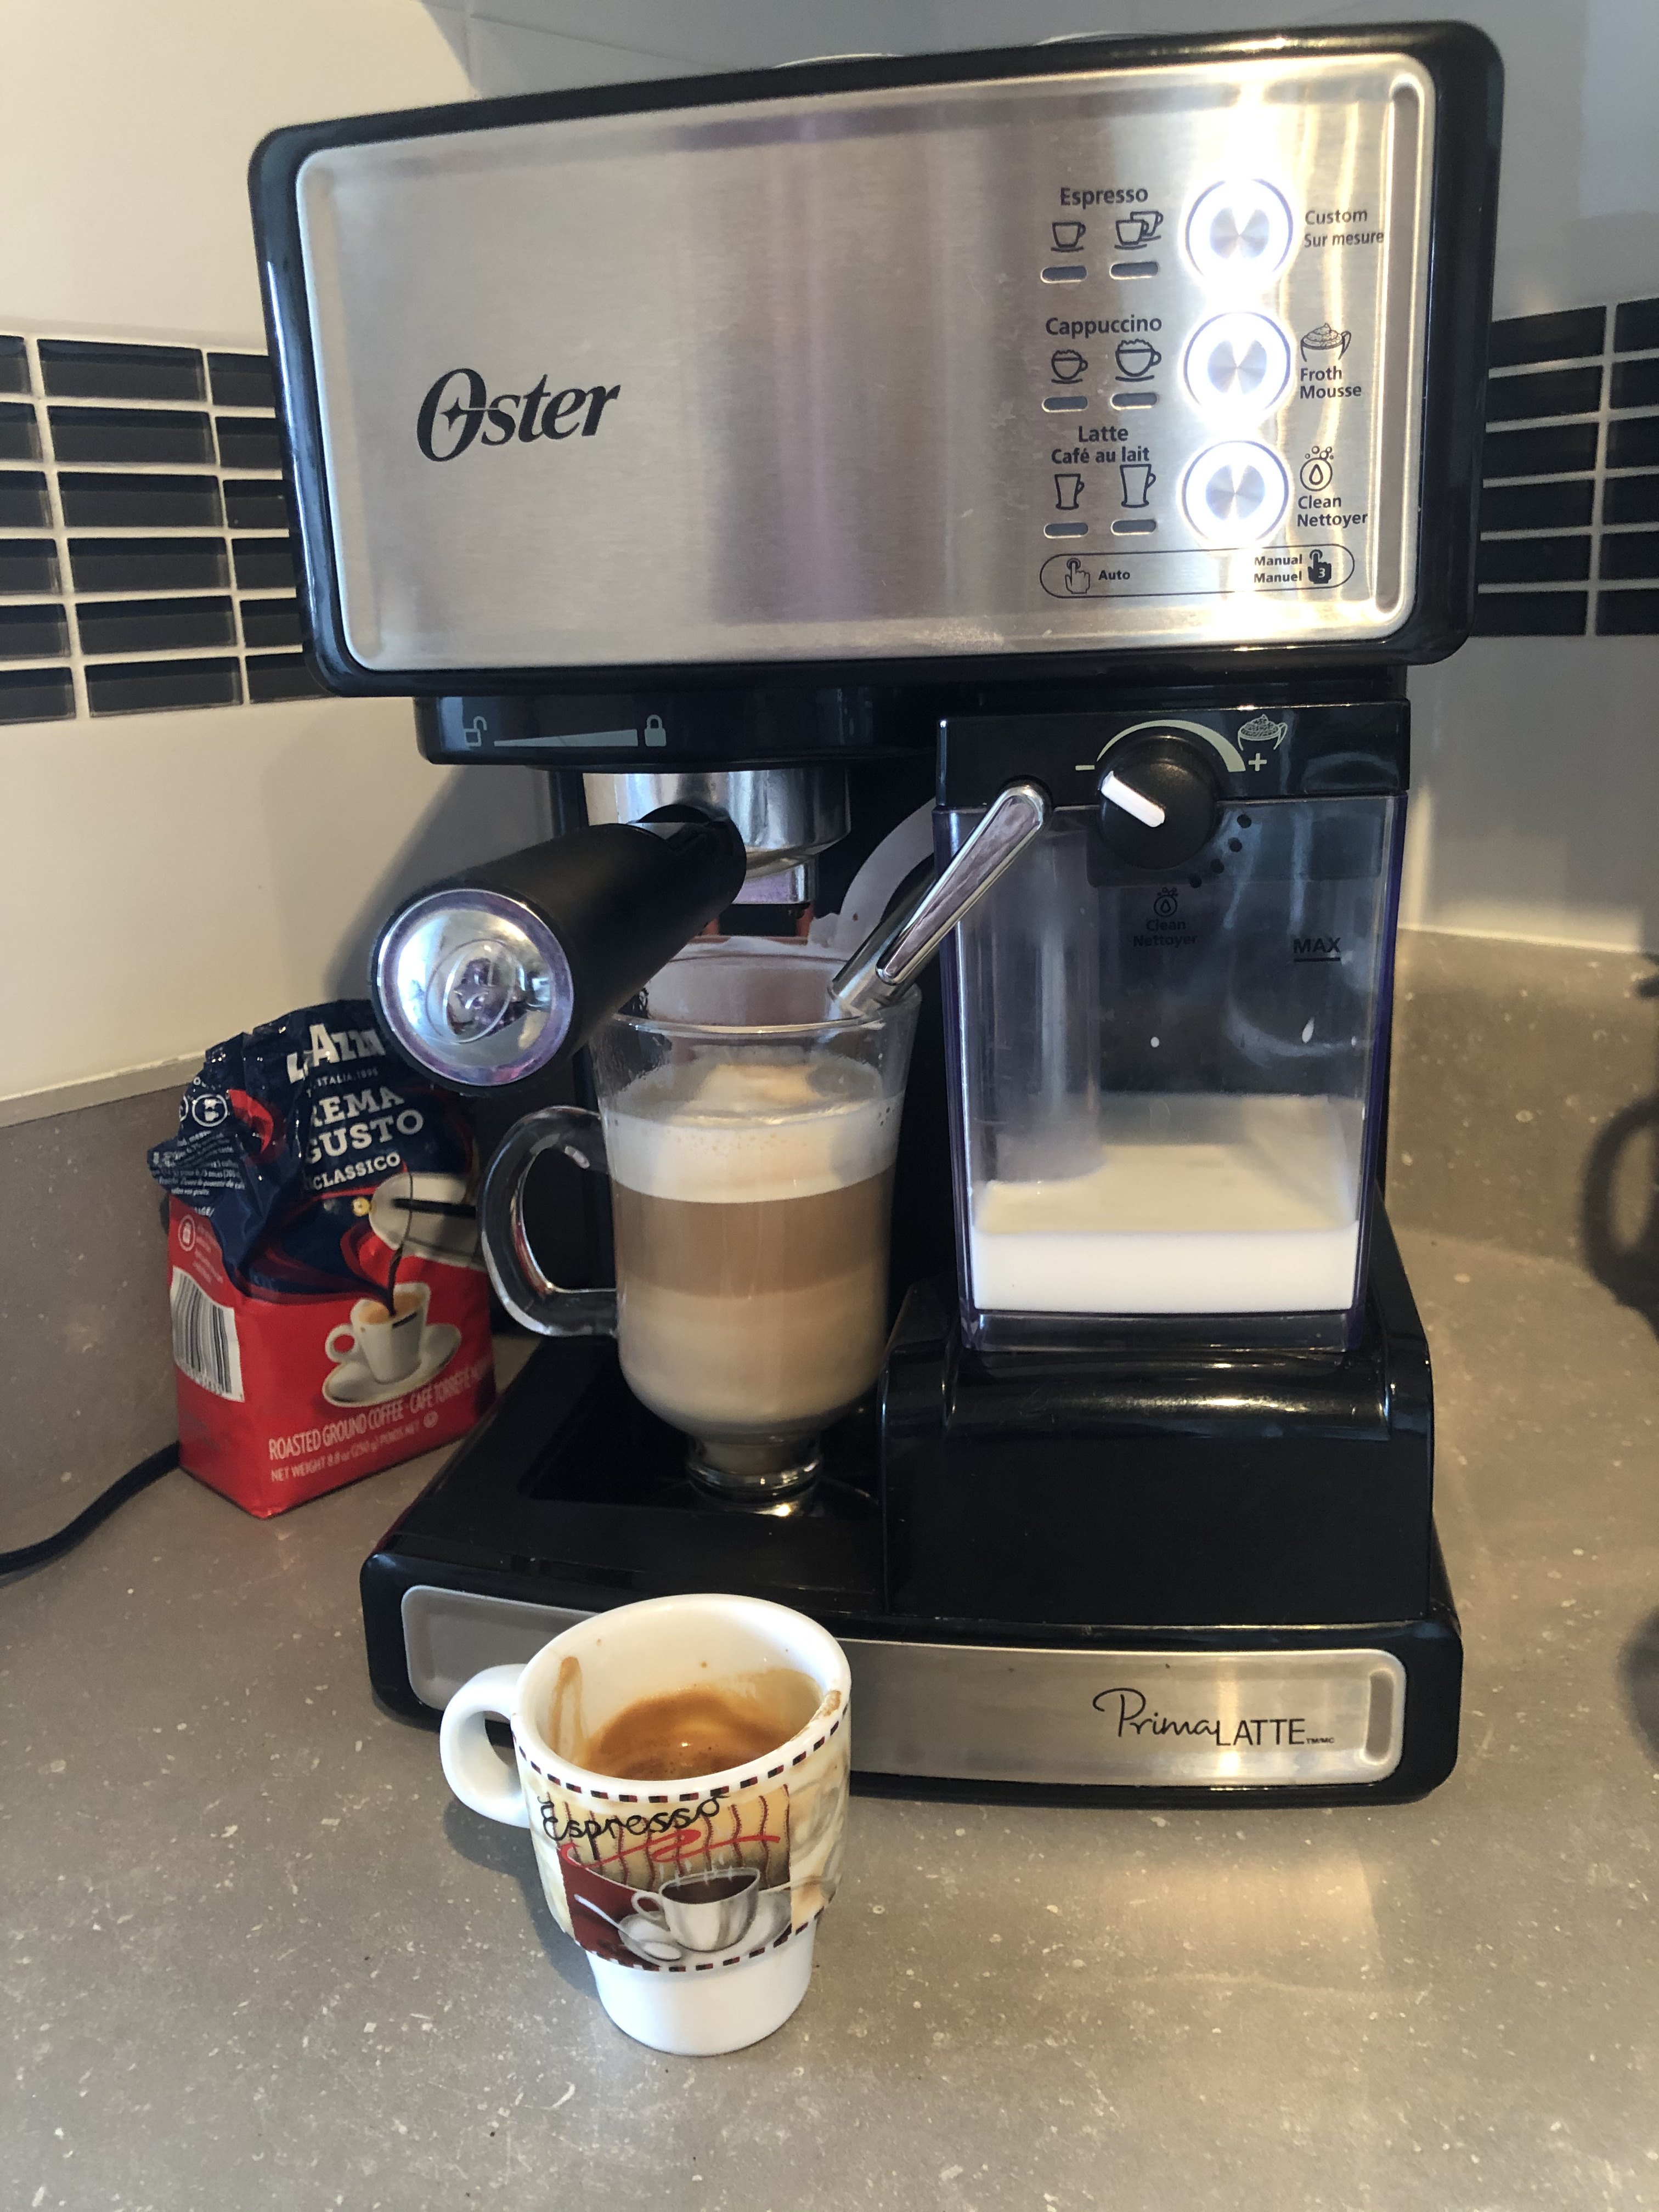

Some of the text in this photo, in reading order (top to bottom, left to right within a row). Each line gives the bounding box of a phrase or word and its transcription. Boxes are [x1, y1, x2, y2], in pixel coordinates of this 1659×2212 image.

[1060, 187, 1148, 207] Espresso
[1305, 209, 1368, 225] Custom
[1304, 229, 1384, 248] Sur mesure
[1046, 314, 1163, 339] Cappuccino
[1300, 365, 1342, 382] Froth
[1300, 383, 1362, 399] Mousse
[417, 368, 621, 462] Oster
[1078, 425, 1128, 443] Latte
[1052, 447, 1149, 465] Café au lait
[1297, 495, 1342, 509] Clean
[1297, 511, 1368, 528] Nettoyer
[1254, 554, 1303, 567] Manual
[1098, 569, 1131, 582] Auto
[1254, 571, 1302, 584] Manuel
[1318, 567, 1325, 578] 3
[1146, 919, 1186, 932] Clean
[1133, 935, 1198, 948] Nettoyer
[1293, 938, 1341, 953] MAX
[313, 1151, 401, 1190] CLASSICO
[268, 1429, 321, 1460] ROASTED
[322, 1414, 367, 1446] GROUND
[368, 1401, 405, 1431] COFFEE
[271, 1466, 289, 1482] NET
[291, 1454, 326, 1477] WEIGHT
[537, 1787, 731, 1860] Espresso
